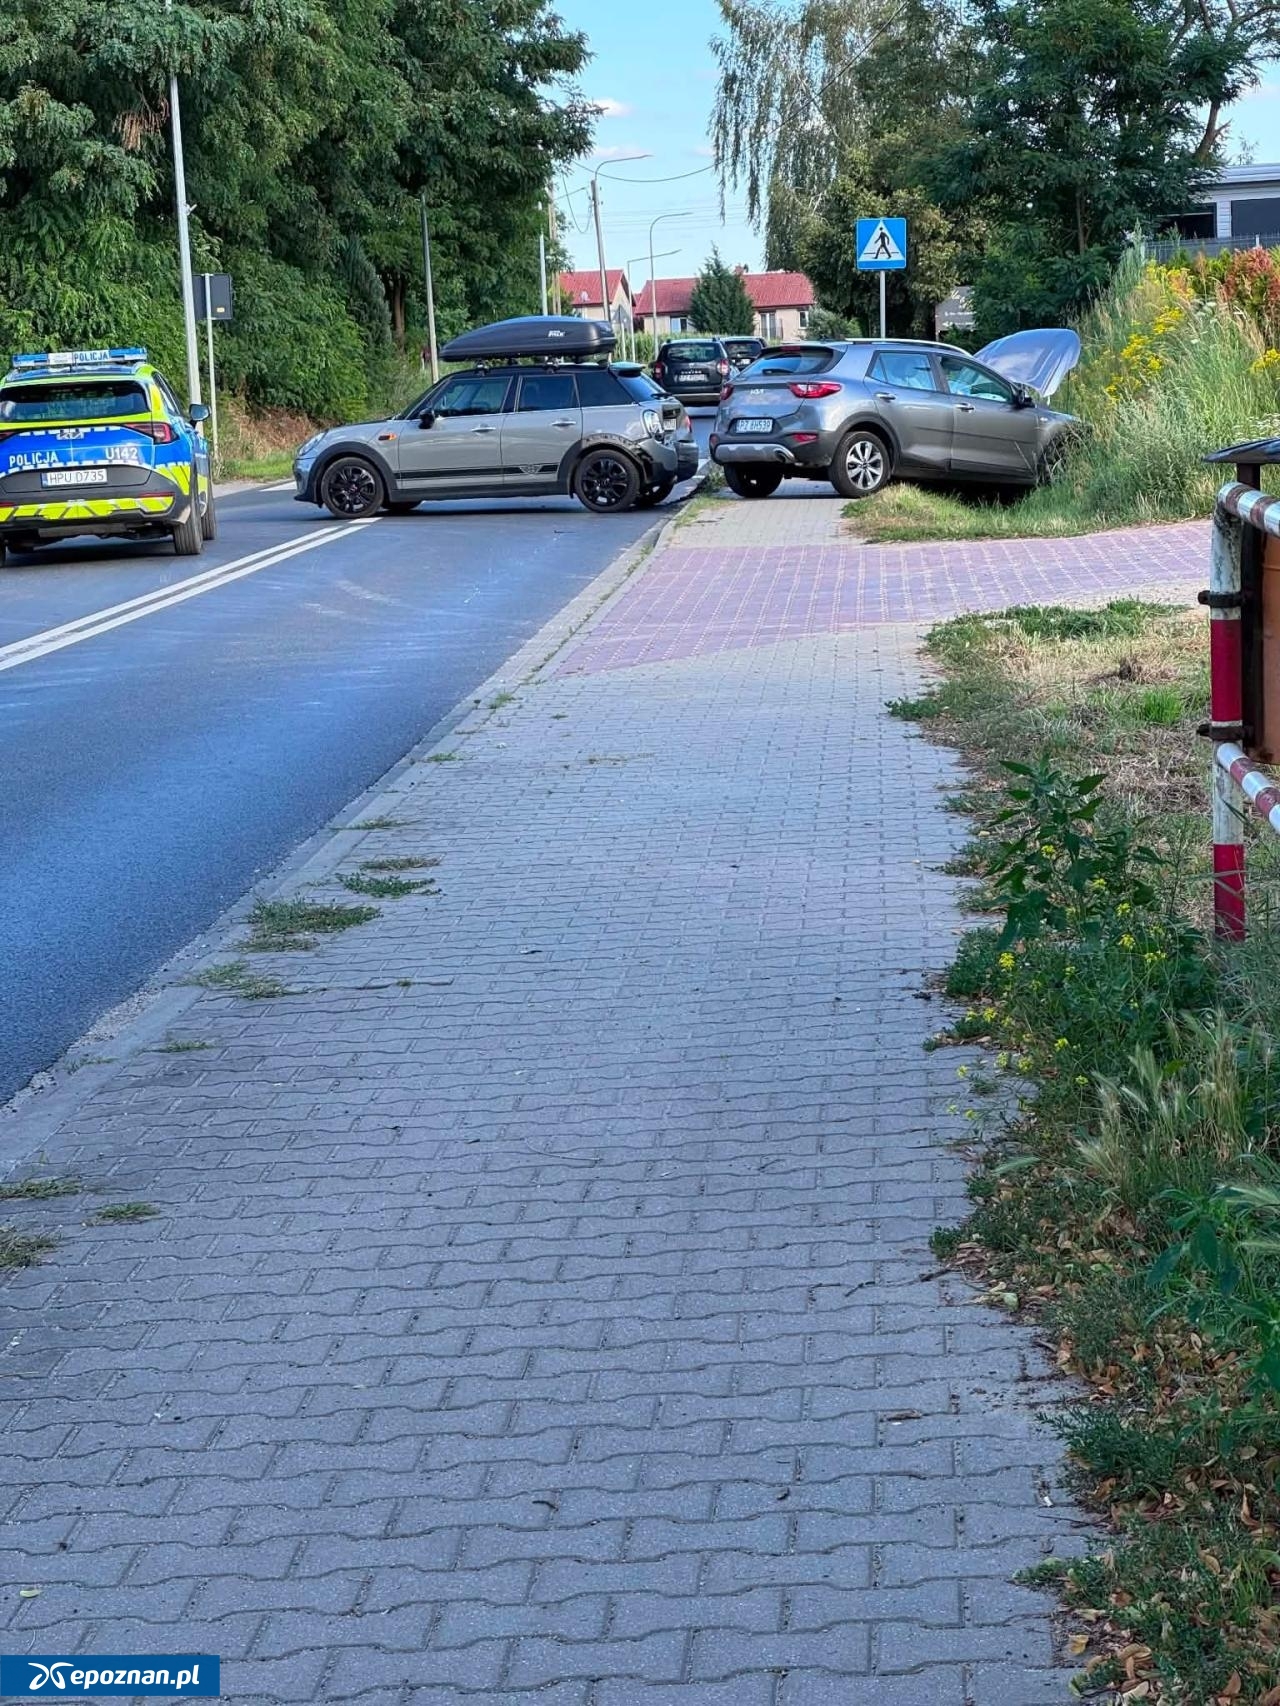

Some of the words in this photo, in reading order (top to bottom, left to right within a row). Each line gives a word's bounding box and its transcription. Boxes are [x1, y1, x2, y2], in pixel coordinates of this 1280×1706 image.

[74, 350, 109, 362] POLICJA
[9, 450, 59, 467] POLICJA
[105, 446, 138, 460] U142
[49, 472, 72, 484] HPU
[75, 470, 104, 483] D735
